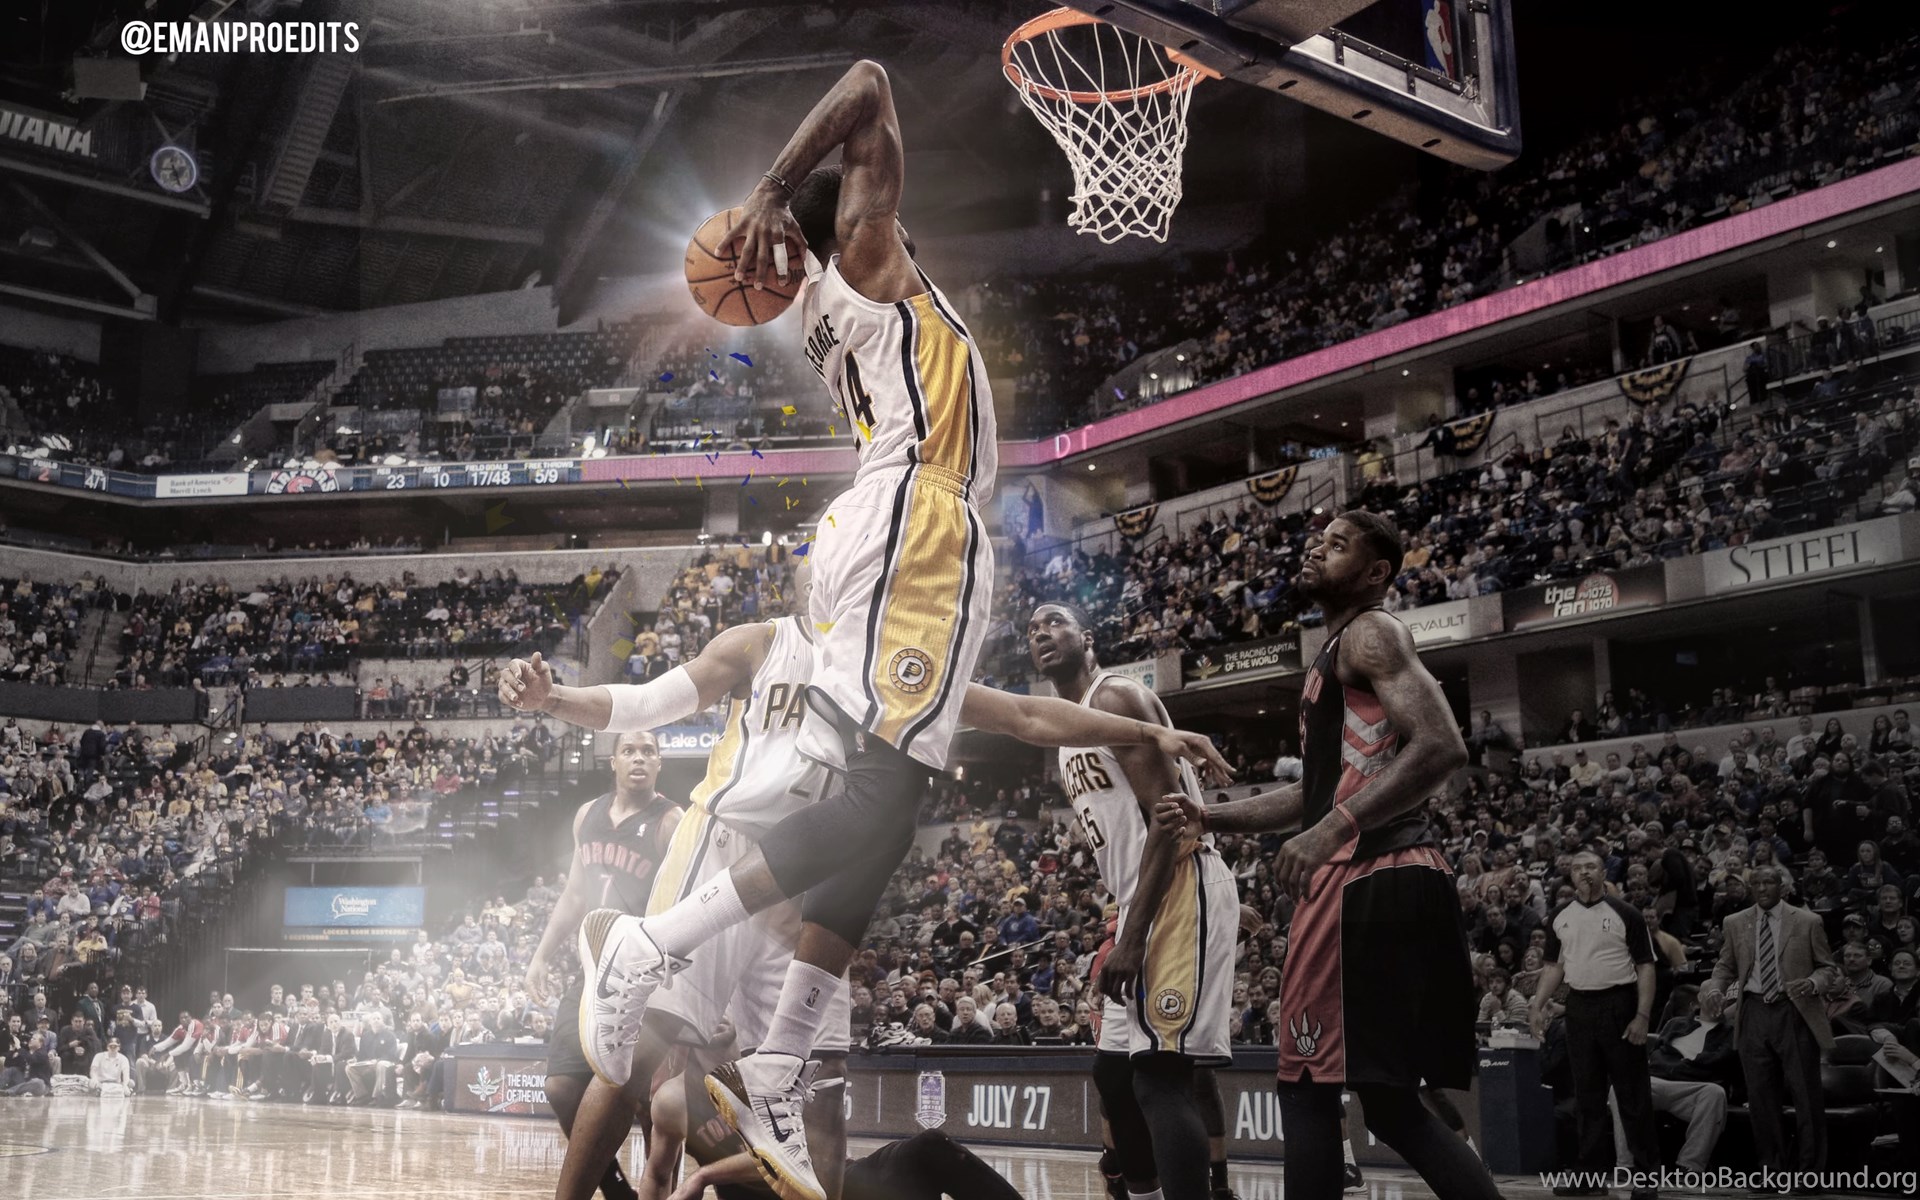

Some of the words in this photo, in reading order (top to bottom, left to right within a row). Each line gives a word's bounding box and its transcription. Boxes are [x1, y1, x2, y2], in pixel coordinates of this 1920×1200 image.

[38, 467, 50, 481] 2
[465, 464, 485, 472] FIELD
[535, 468, 559, 484] 5/9
[84, 474, 107, 490] 4/1
[386, 474, 406, 489] 23
[432, 472, 450, 487] 10
[471, 470, 511, 486] 17/48
[1545, 584, 1576, 604] the
[1552, 599, 1585, 618] fan
[1588, 596, 1613, 612] 1070
[1224, 652, 1239, 662] THE
[1239, 647, 1267, 659] RACING
[1267, 641, 1298, 655] CAPITAL
[1225, 661, 1236, 672] OF
[1236, 659, 1251, 670] THE
[1251, 654, 1279, 668] WORLD
[762, 682, 806, 733] PA
[660, 732, 698, 748] Lake
[1063, 751, 1114, 802] CERS
[580, 841, 653, 880] ORONTO
[599, 873, 614, 906] 7
[507, 1073, 522, 1088] THE
[522, 1074, 547, 1088] RACIN
[506, 1088, 517, 1102] OF
[517, 1089, 531, 1103] THE
[967, 1084, 1017, 1129] JULY
[1023, 1085, 1051, 1131] 27
[696, 1113, 733, 1148] TO
